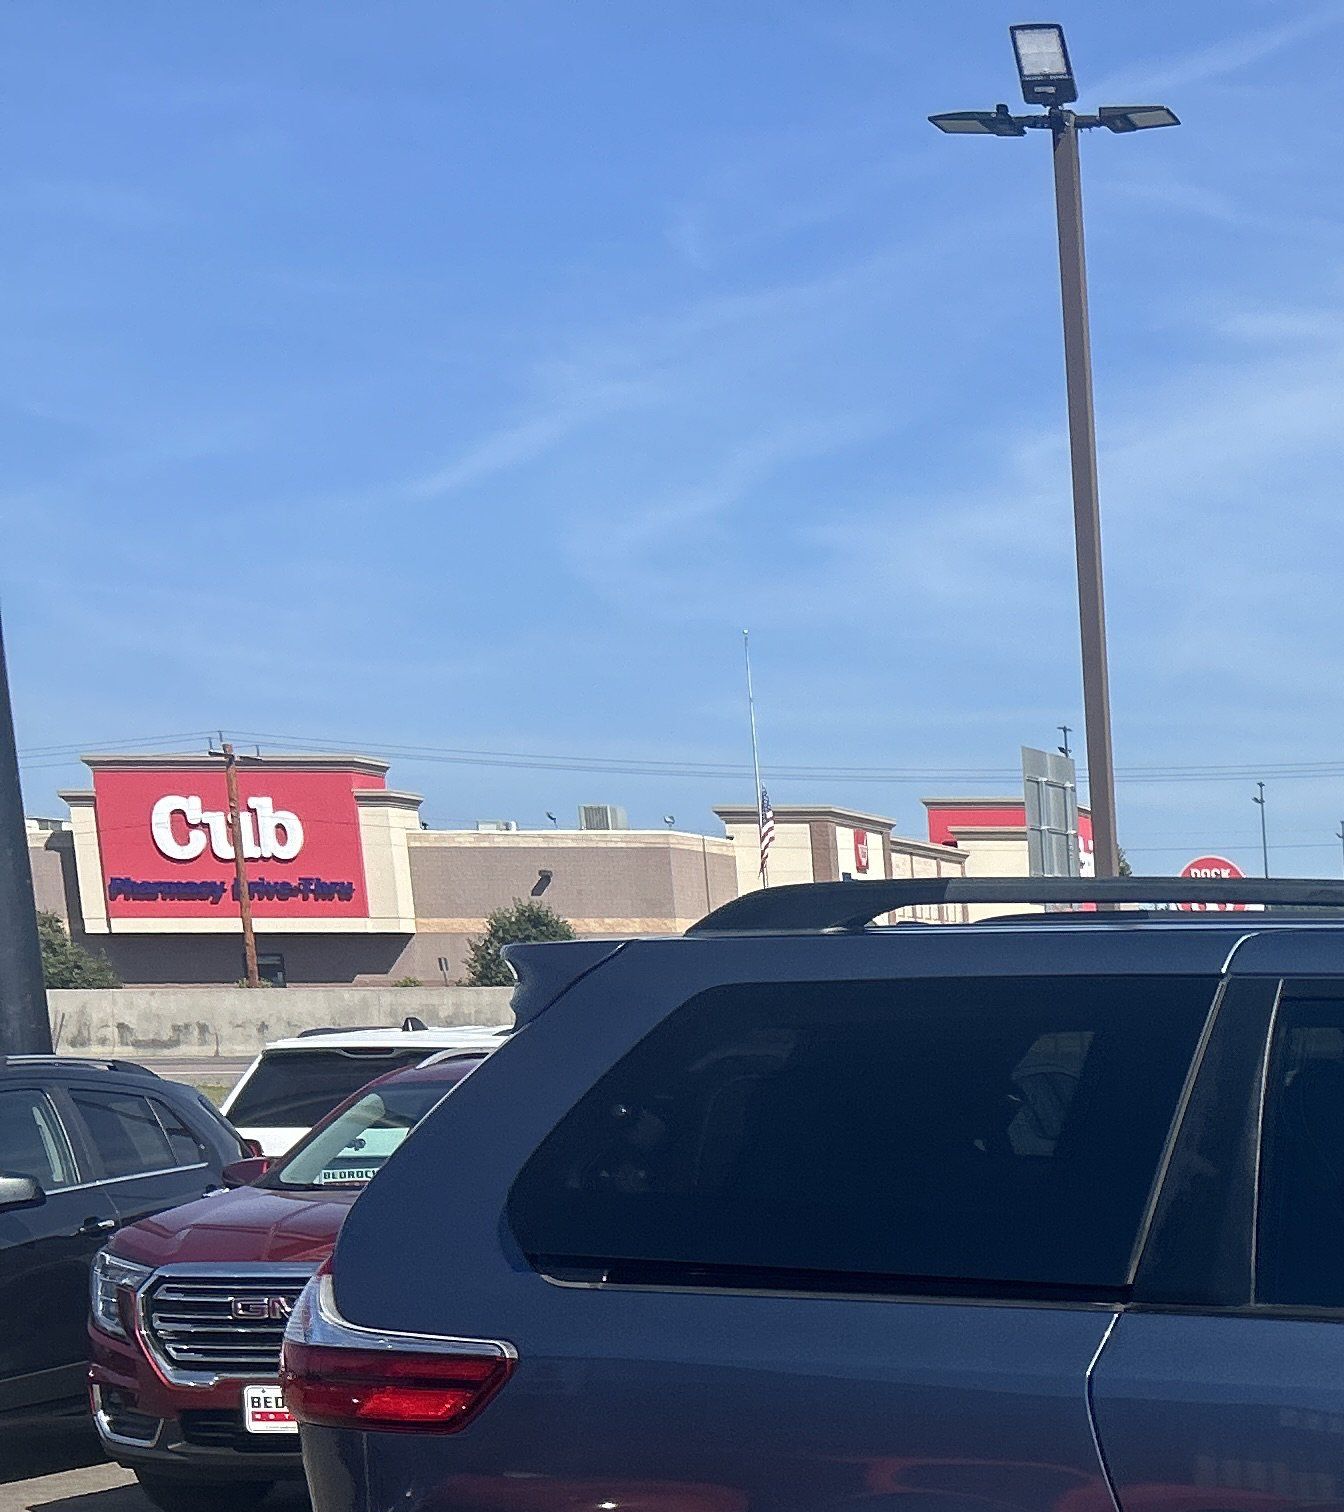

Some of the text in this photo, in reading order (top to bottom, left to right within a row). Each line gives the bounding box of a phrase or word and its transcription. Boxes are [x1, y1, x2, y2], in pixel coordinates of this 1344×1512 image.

[152, 795, 304, 863] Cub
[108, 877, 227, 905] Pharmacy
[231, 1297, 293, 1319] GM
